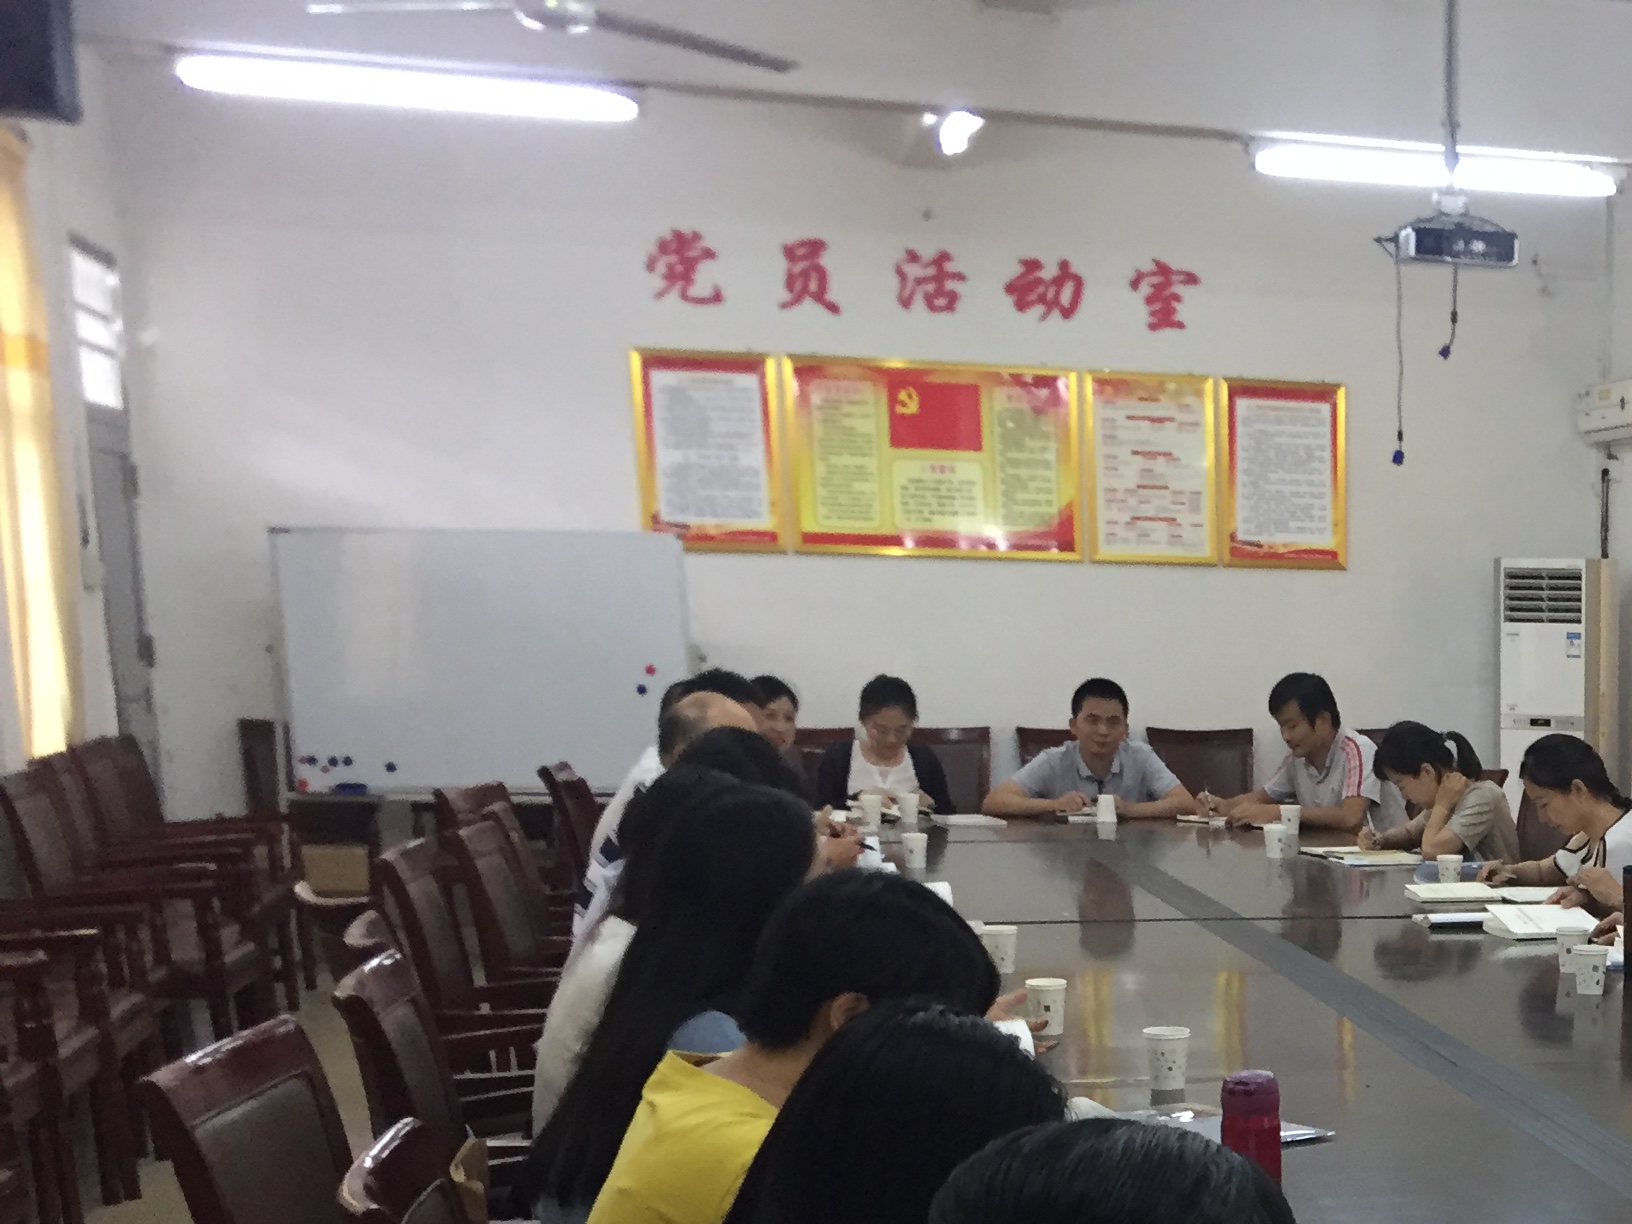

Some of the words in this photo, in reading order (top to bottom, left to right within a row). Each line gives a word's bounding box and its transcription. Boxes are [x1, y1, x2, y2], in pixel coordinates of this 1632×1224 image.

[645, 228, 1202, 333] 党员活动室
